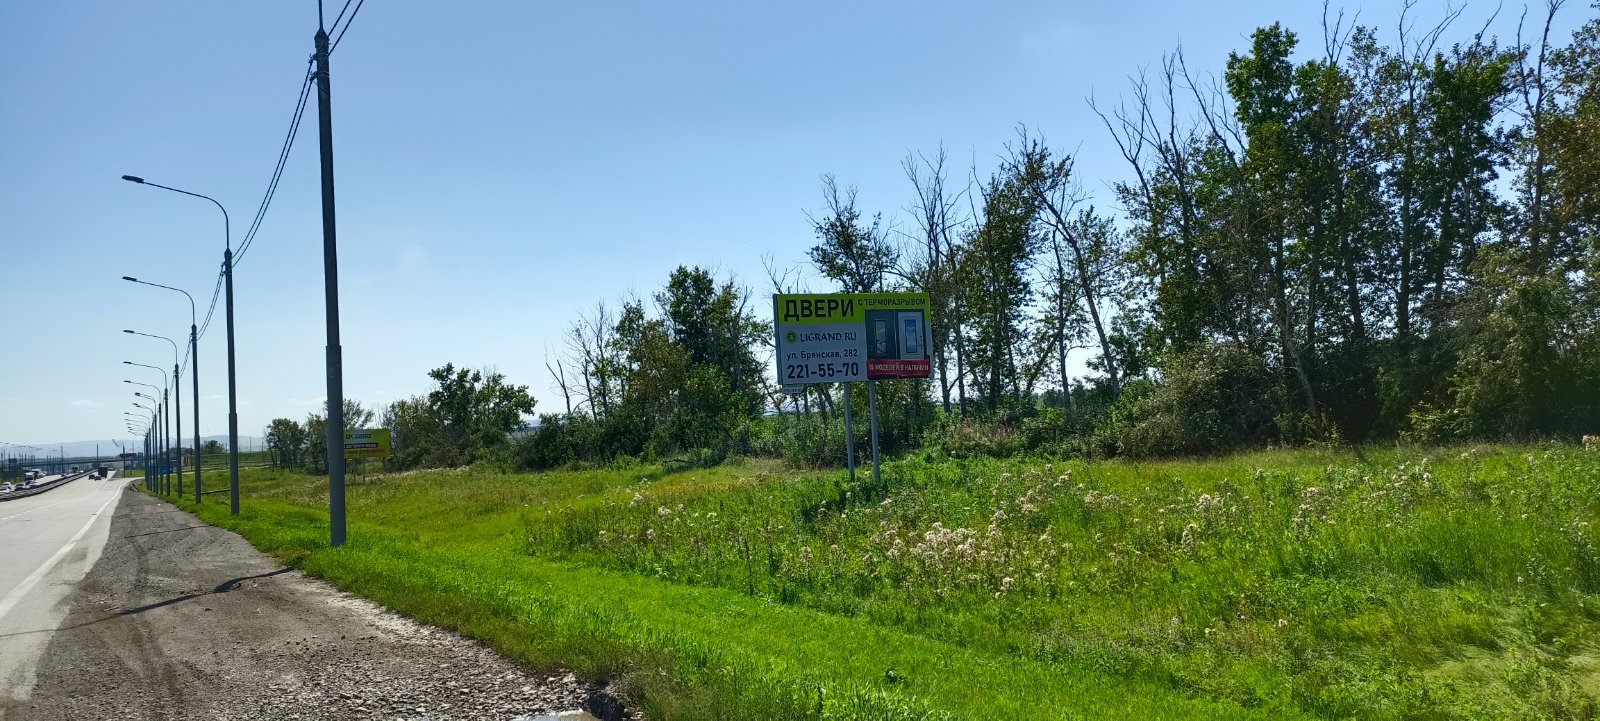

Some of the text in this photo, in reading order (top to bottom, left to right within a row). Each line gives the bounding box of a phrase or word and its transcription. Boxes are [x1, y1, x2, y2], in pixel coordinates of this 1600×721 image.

[865, 298, 926, 306] ТЕРМОРАЗРЫВОМ
[784, 298, 854, 322] ДВЕРИ
[800, 332, 857, 342] LIGRAND.RU
[786, 349, 858, 360] ул. Брянская, 282
[787, 362, 859, 379] 221-55-70
[875, 362, 900, 371] МОДЕЛЕЙ
